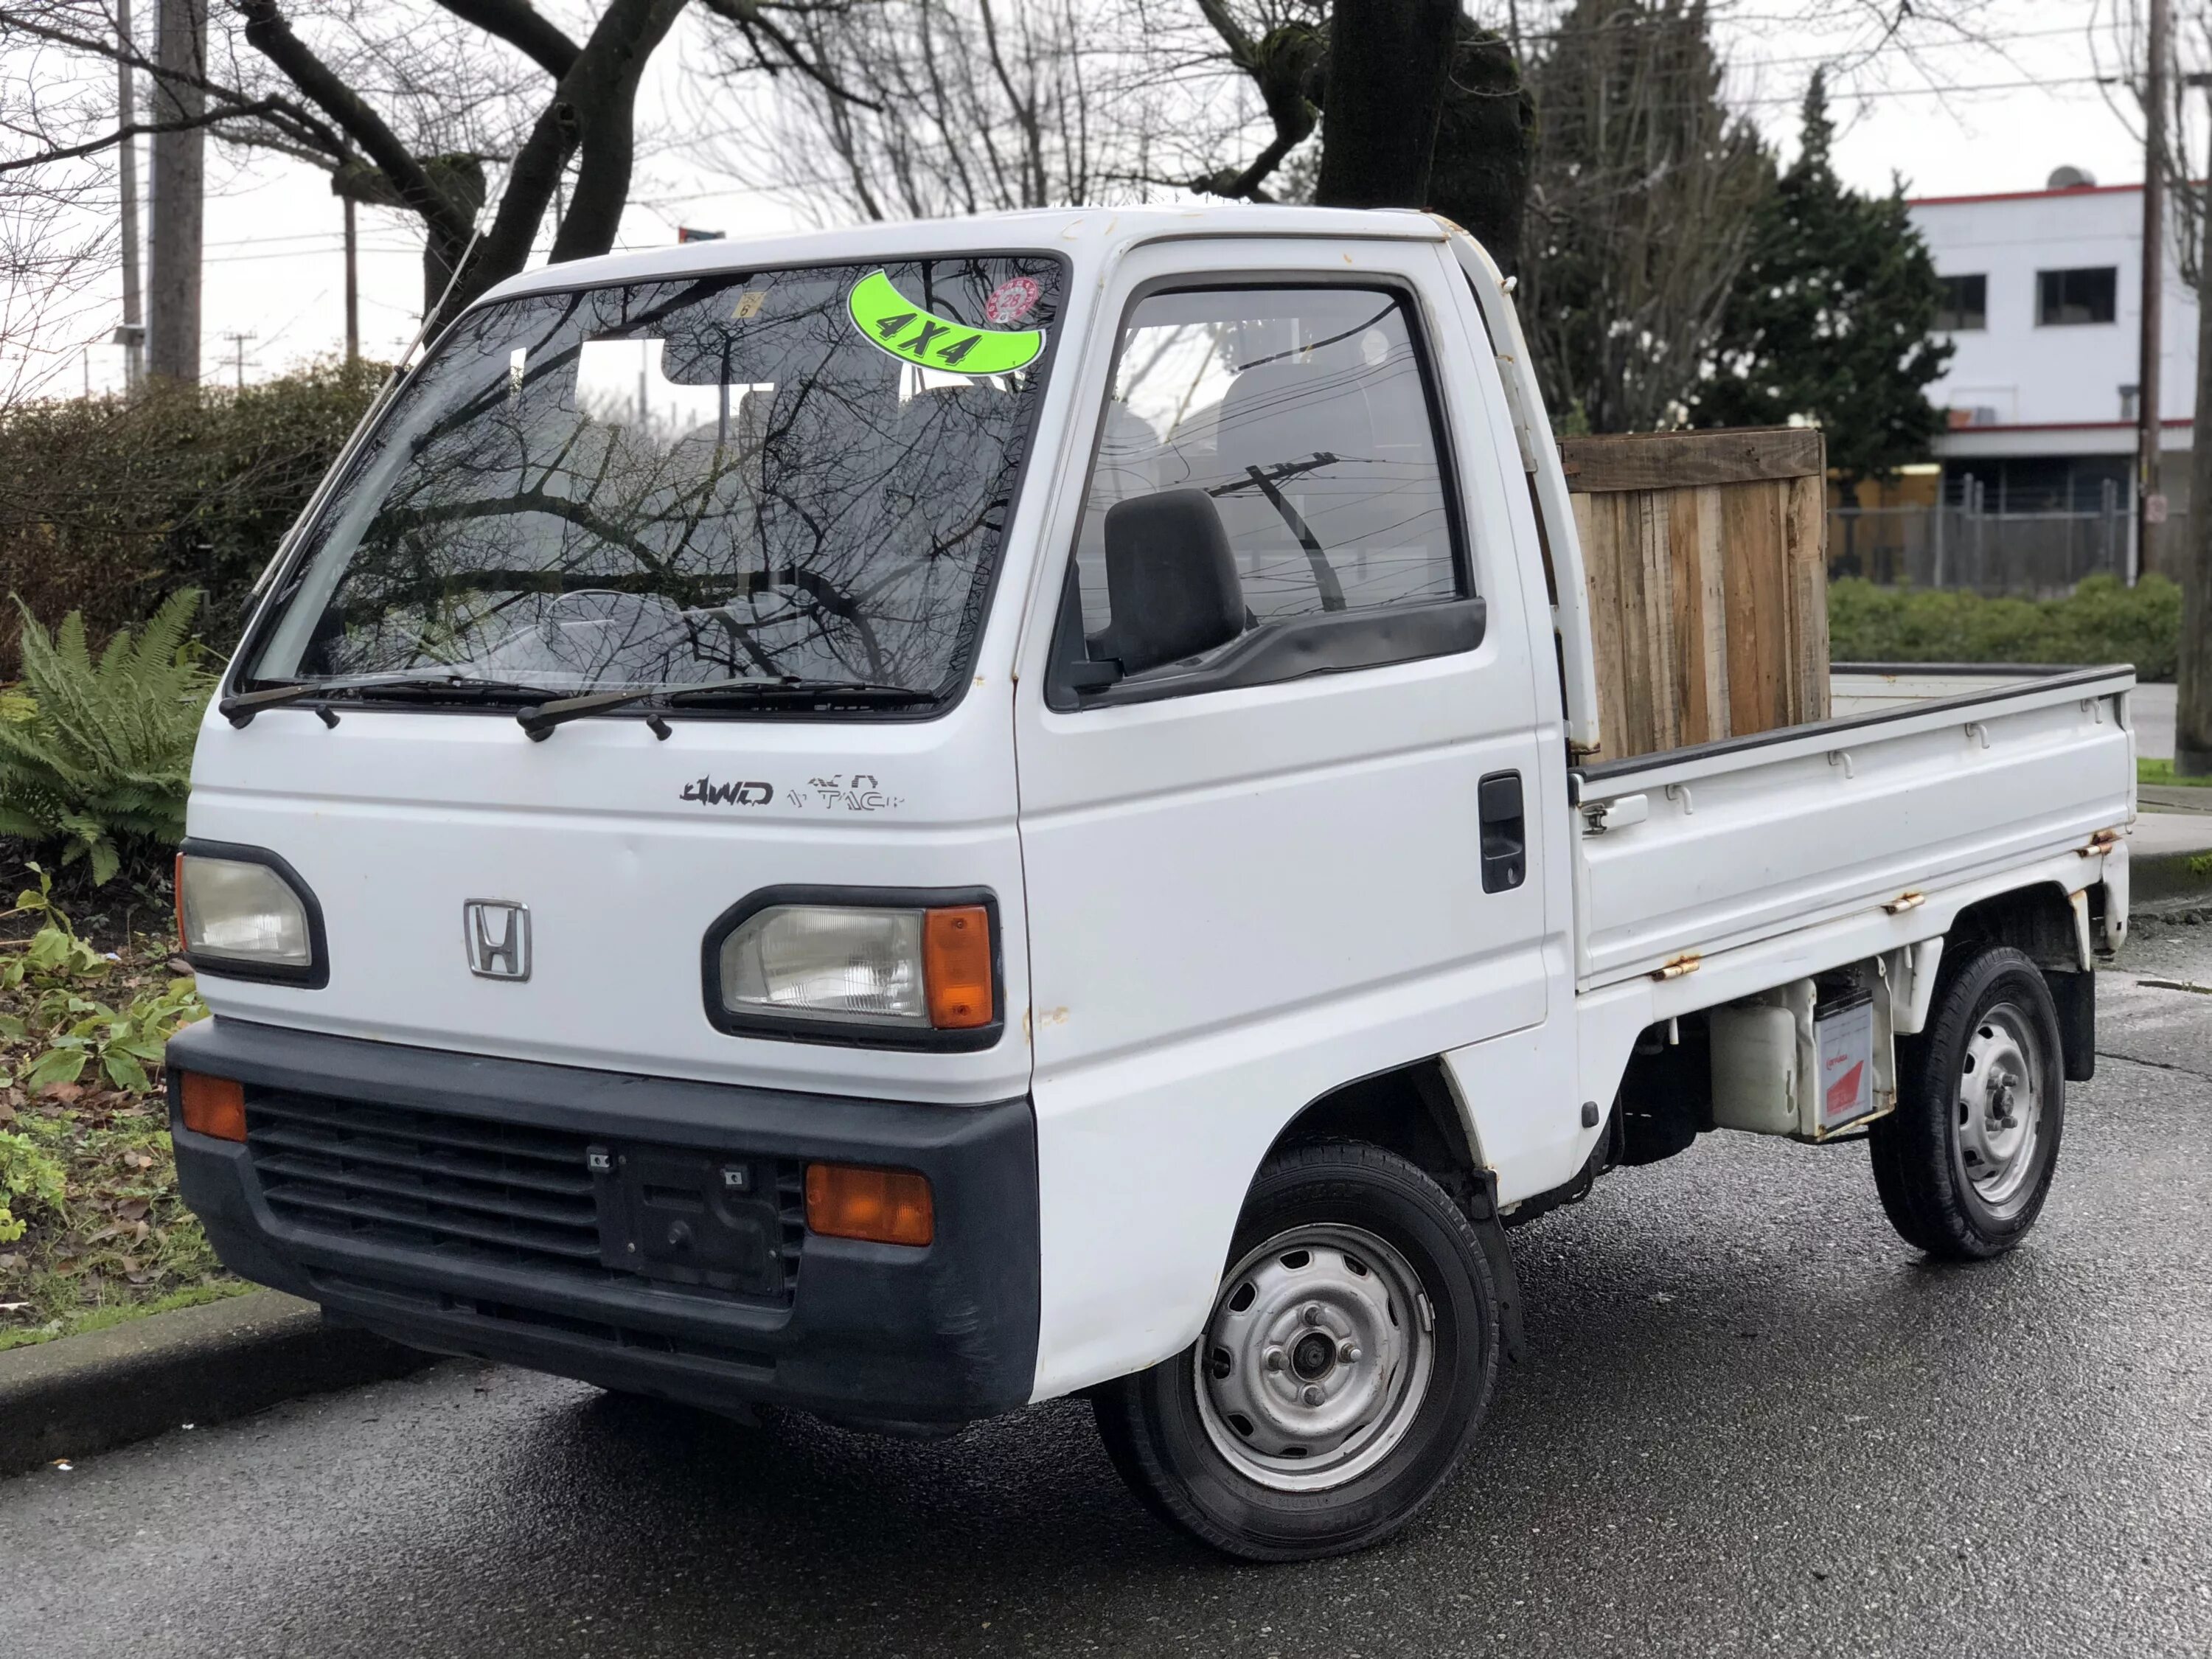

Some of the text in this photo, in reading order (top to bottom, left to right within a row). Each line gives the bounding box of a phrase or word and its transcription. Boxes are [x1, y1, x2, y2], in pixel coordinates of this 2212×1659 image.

[1001, 293, 1022, 307] 28
[876, 312, 983, 366] 4X4
[679, 774, 774, 807] 4WD
